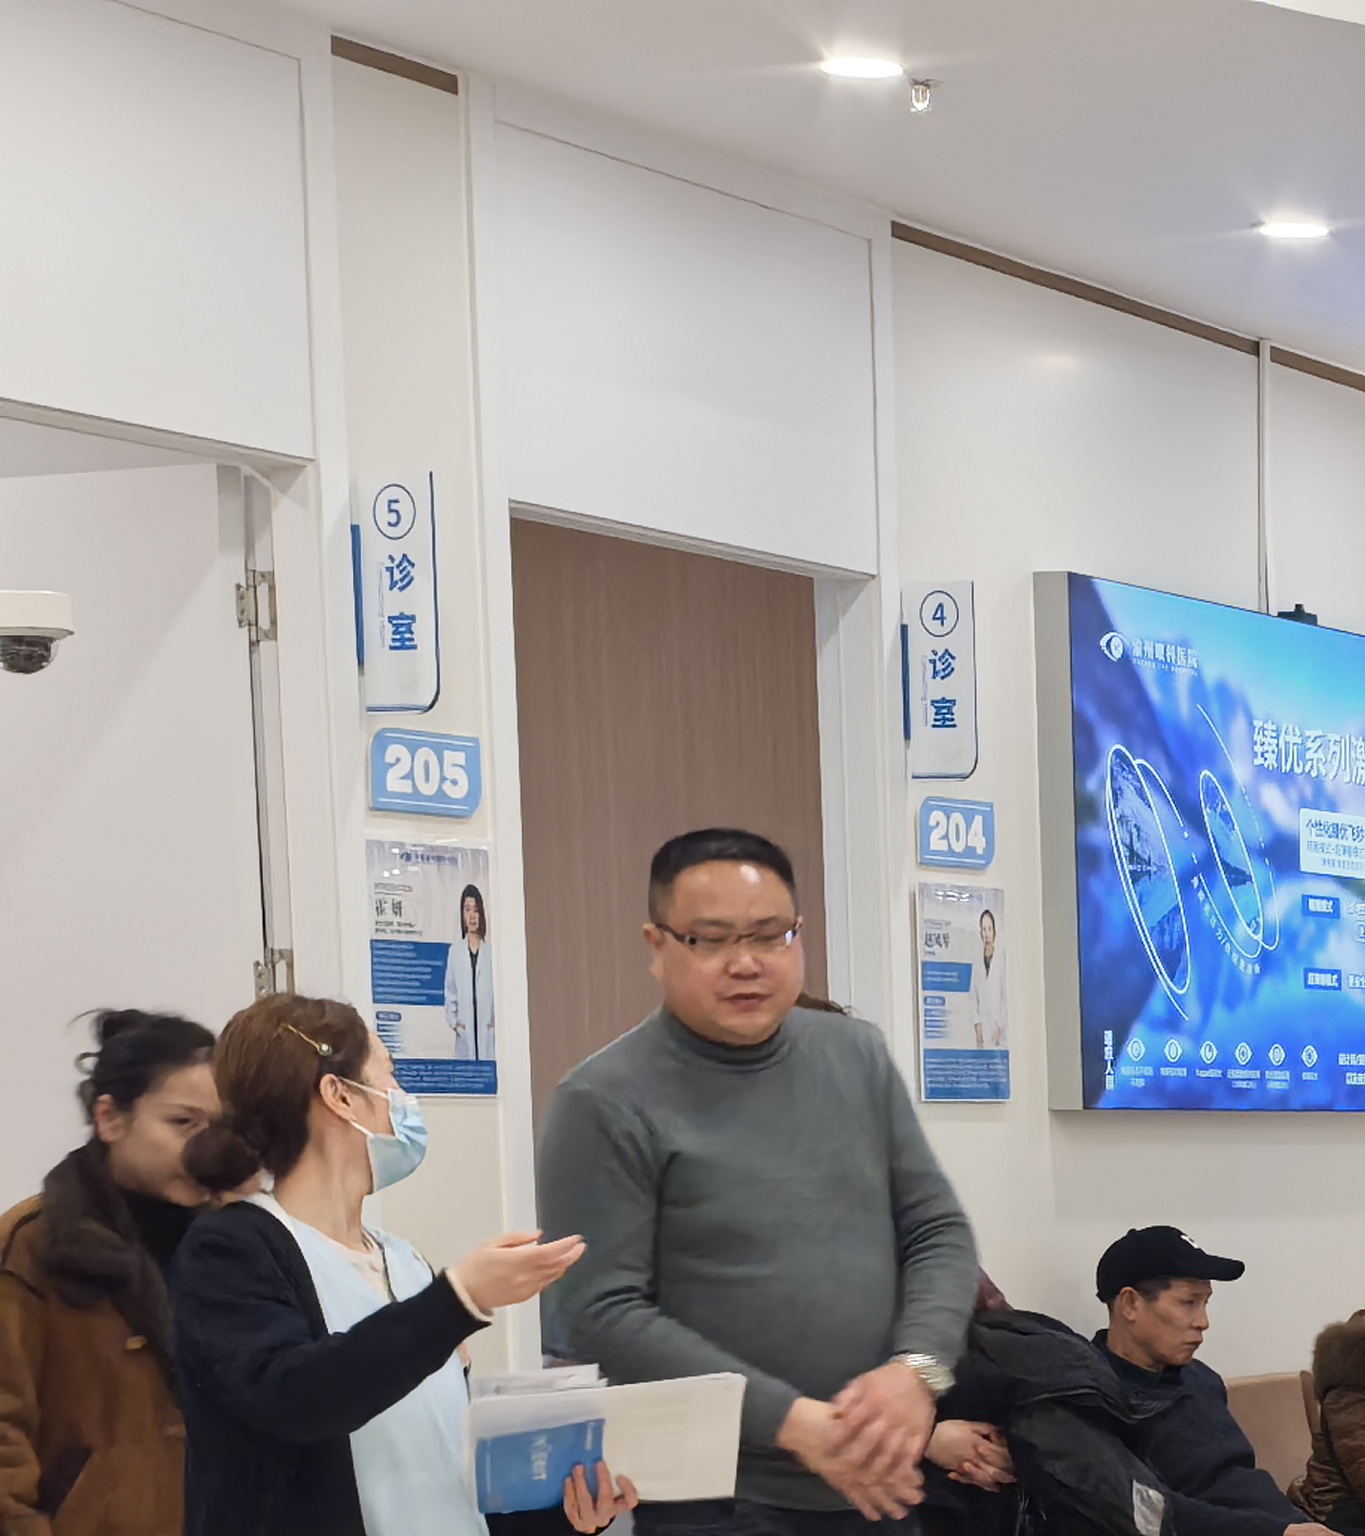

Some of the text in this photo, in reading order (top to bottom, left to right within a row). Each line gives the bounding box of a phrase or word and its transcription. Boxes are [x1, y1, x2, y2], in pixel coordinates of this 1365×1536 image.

[385, 552, 418, 651] 诊室
[928, 648, 958, 729] 诊室
[383, 743, 469, 799] 205
[928, 810, 986, 855] 204
